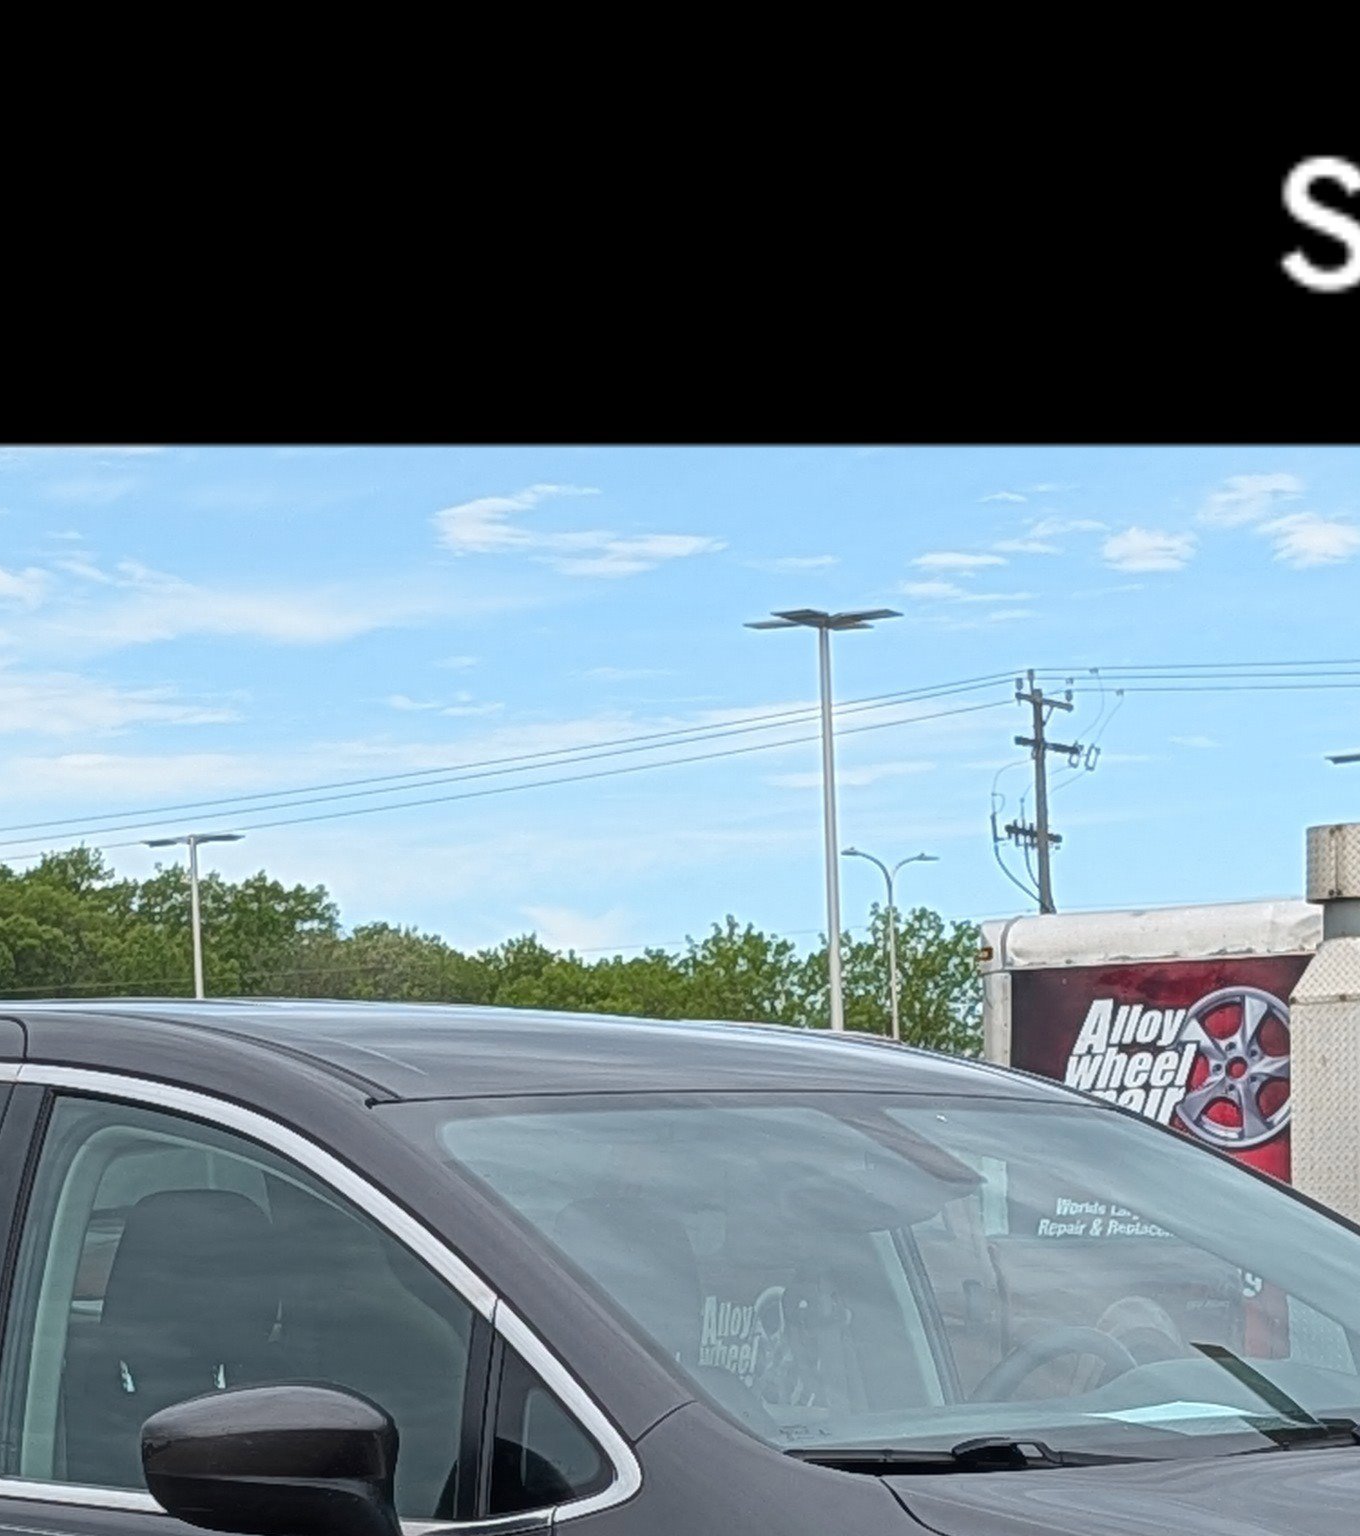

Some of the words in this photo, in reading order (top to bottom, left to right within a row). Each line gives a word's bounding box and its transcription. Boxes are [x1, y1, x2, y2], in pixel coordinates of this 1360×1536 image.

[1073, 998, 1187, 1055] Alloy
[1064, 1043, 1197, 1091] wheel
[1038, 1219, 1086, 1238] Repair
[1089, 1218, 1103, 1236] &
